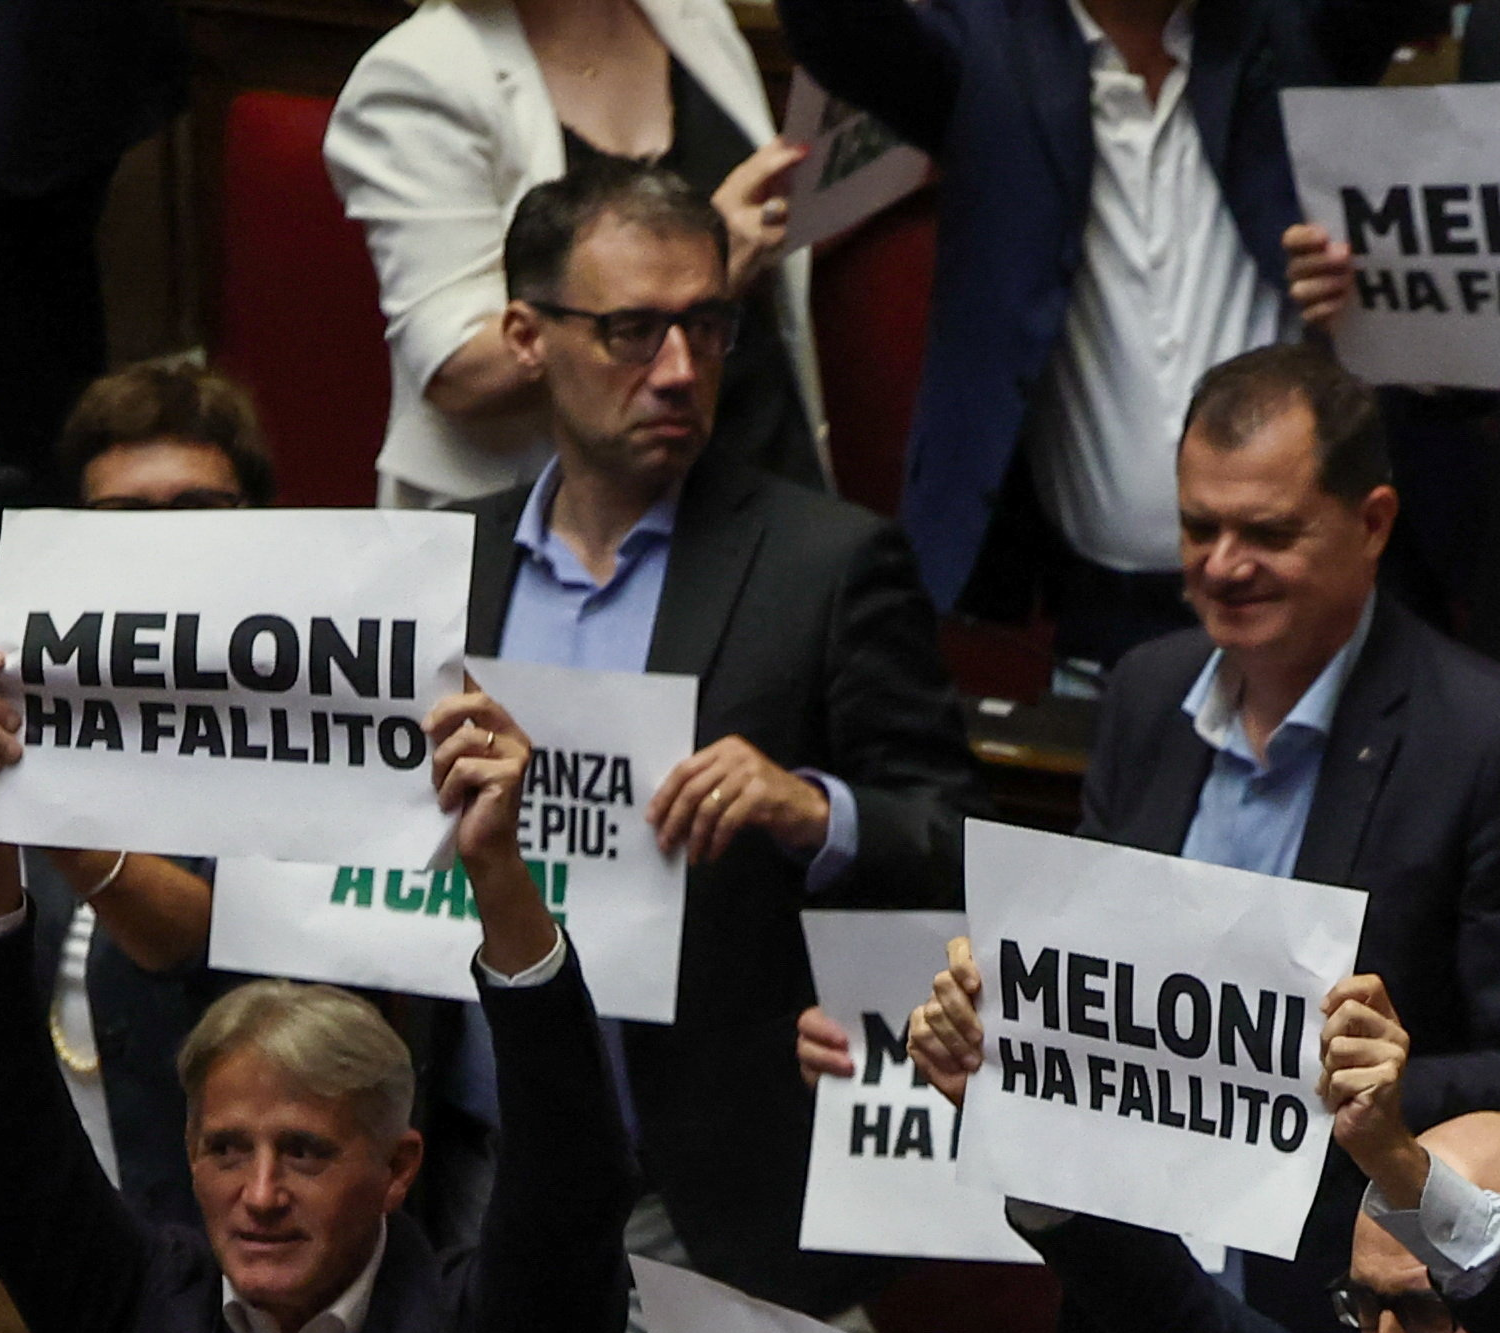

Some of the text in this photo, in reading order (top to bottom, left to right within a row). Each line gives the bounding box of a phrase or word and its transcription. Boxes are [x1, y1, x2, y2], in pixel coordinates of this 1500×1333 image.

[1356, 268, 1454, 315] HA
[23, 611, 415, 700] MELONI
[25, 696, 428, 772] HA FALLITO
[999, 939, 1306, 1081] MELONI
[849, 1103, 934, 1160] HA
[1000, 1037, 1079, 1105] HA
[1089, 1055, 1309, 1155] FALLITO
